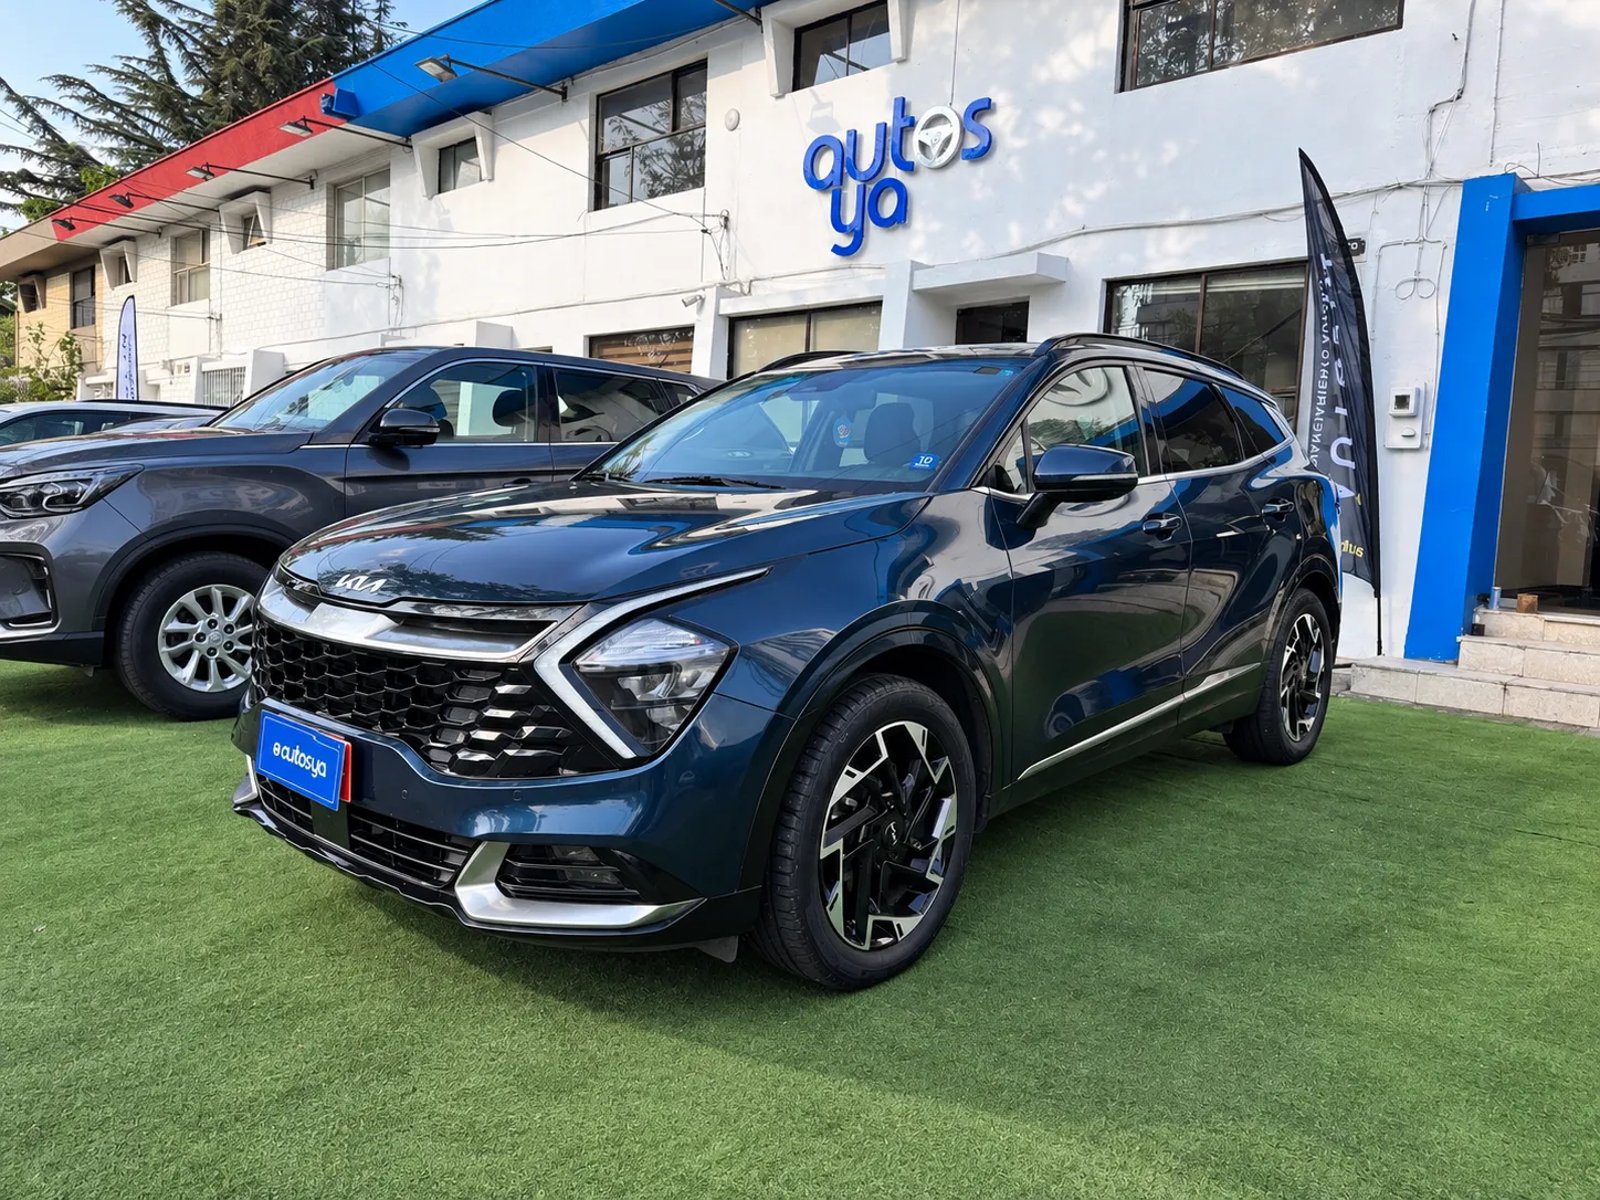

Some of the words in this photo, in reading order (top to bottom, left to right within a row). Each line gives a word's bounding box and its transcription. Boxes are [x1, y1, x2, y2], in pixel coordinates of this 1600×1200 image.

[803, 96, 992, 190] autos
[831, 177, 908, 256] ya
[335, 573, 387, 593] KIA
[281, 744, 327, 778] autosya
